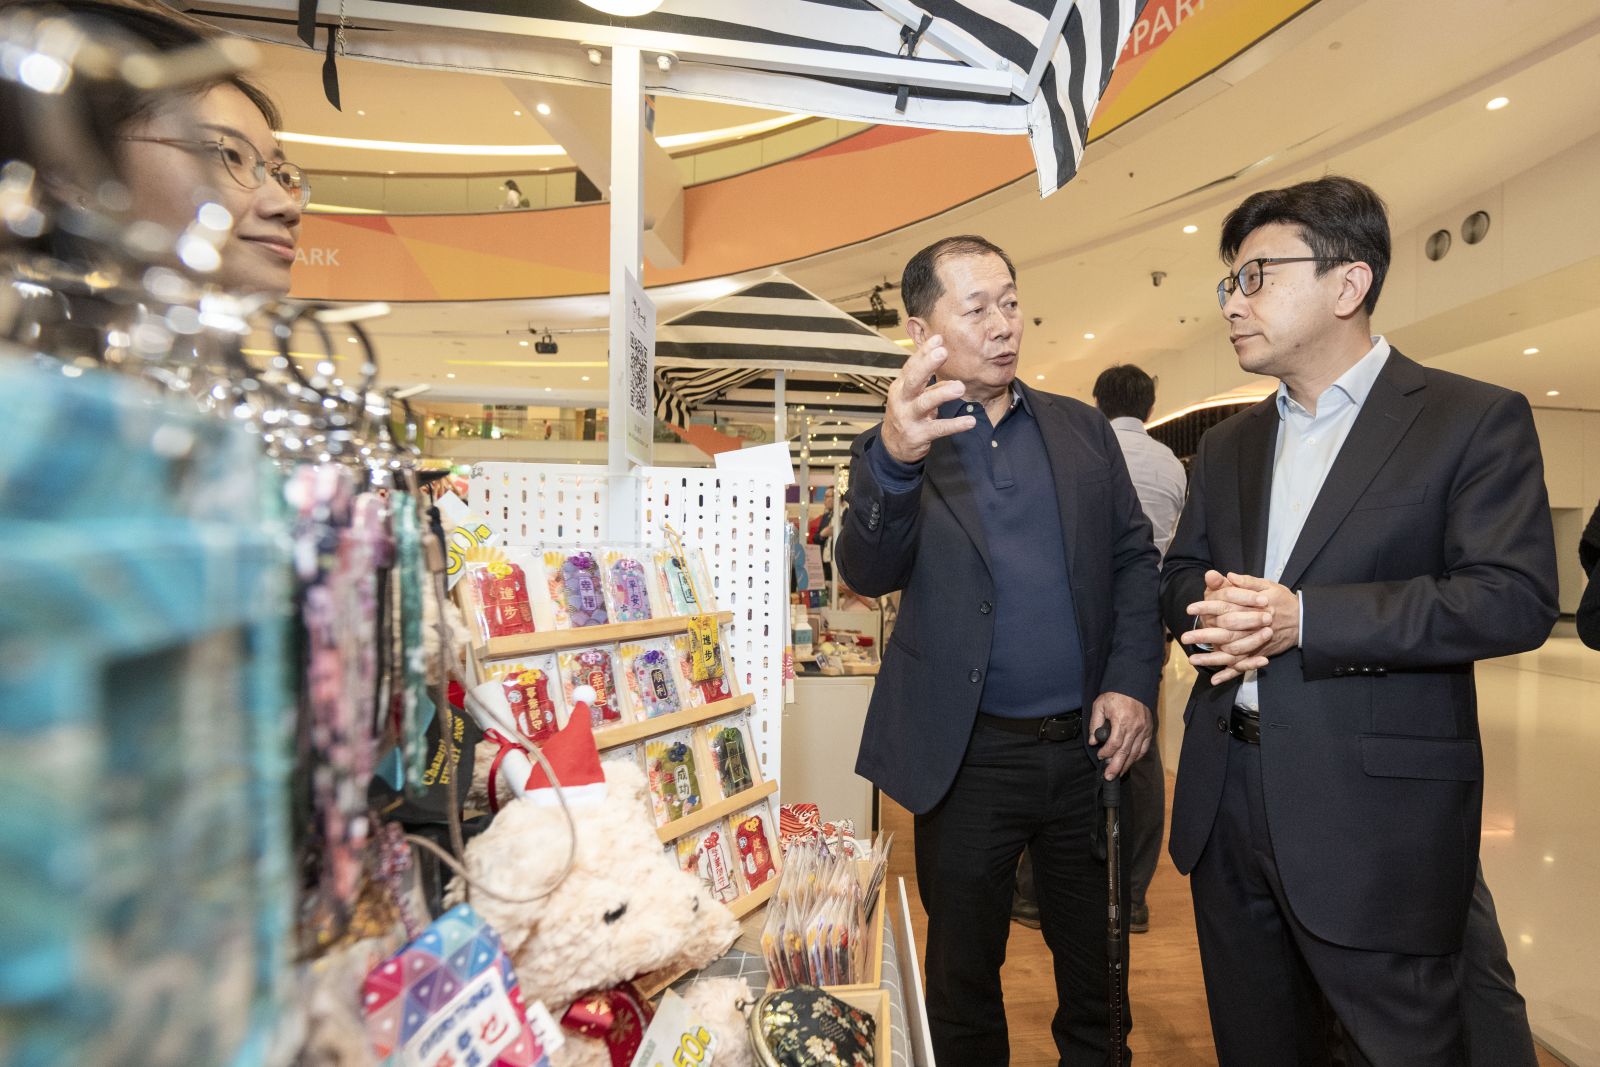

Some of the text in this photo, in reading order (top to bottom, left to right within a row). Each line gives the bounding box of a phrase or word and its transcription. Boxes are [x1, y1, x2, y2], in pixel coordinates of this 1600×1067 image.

[580, 579, 595, 608] 幸福
[628, 579, 641, 606] 平安
[702, 634, 713, 662] 進步
[652, 672, 667, 698] 順利
[677, 767, 690, 796] 成功
